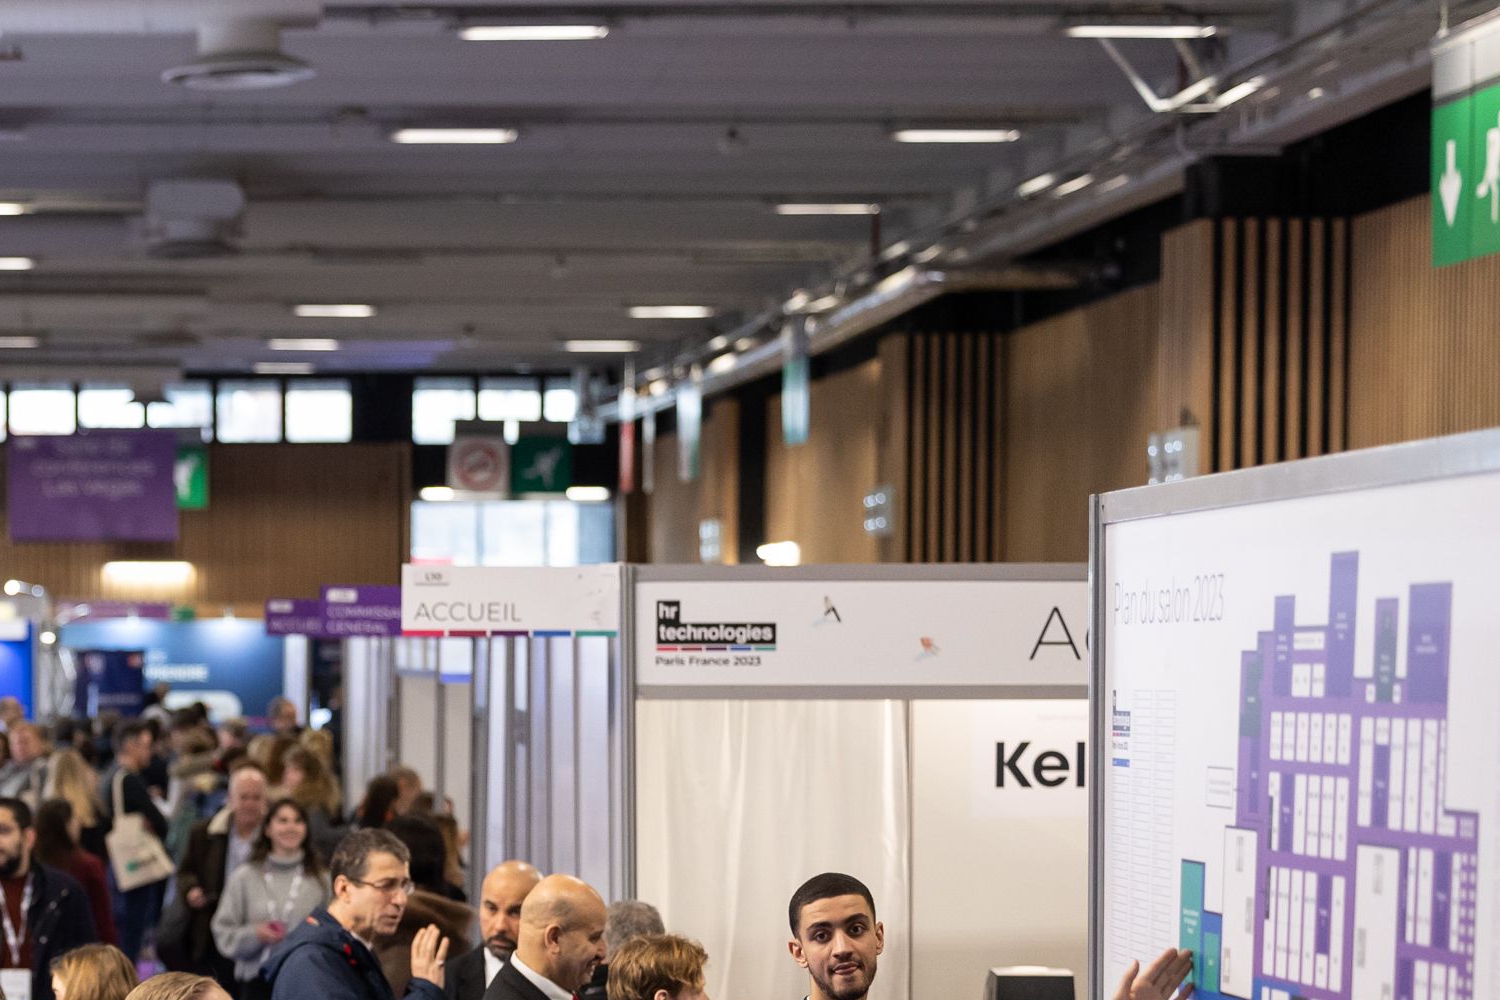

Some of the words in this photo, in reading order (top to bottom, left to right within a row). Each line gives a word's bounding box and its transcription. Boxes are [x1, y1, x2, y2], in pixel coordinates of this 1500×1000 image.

[1113, 580, 1138, 626] Plan
[1140, 577, 1155, 624] du
[1157, 575, 1190, 624] salon
[1193, 573, 1225, 622] 2023
[413, 602, 522, 623] ACCUEIL
[658, 602, 678, 620] hr
[659, 624, 773, 644] technologies
[1029, 606, 1090, 661] A
[655, 656, 685, 667] Paris
[688, 656, 730, 667] France
[733, 656, 762, 667] 2023
[996, 741, 1086, 788] Kel
